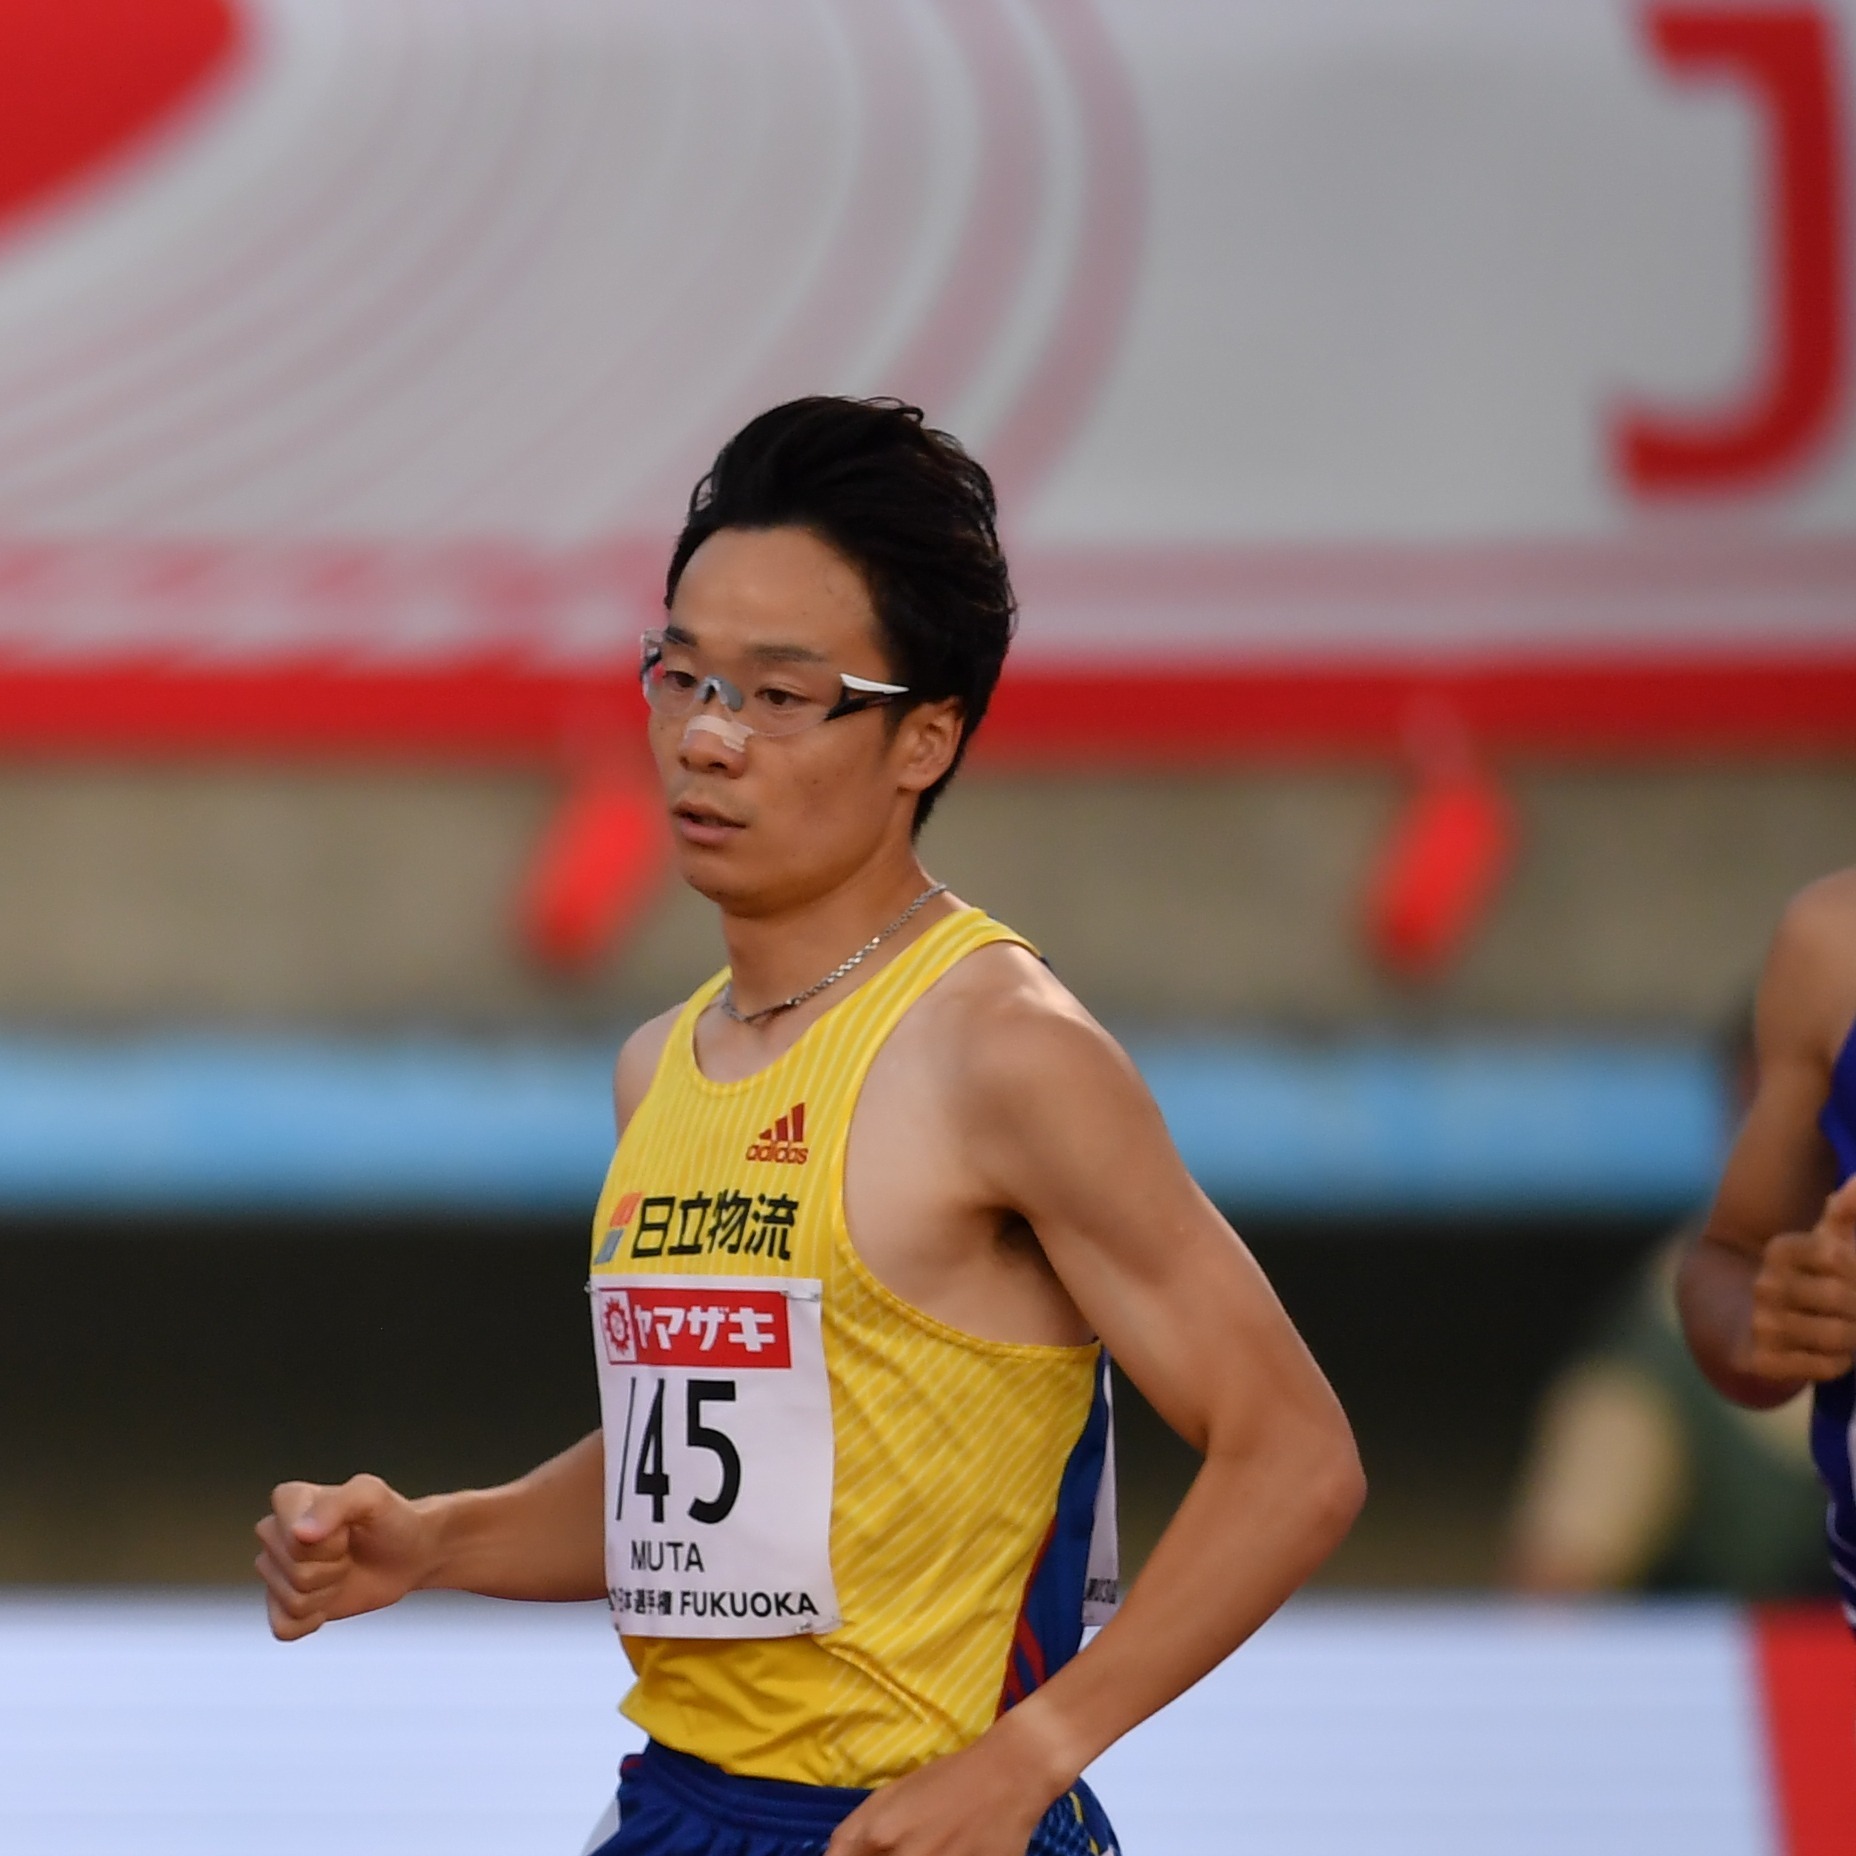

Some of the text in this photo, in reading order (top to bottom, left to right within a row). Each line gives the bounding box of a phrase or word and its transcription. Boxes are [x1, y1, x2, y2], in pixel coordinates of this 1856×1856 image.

[746, 1141, 809, 1165] adidas
[630, 1189, 800, 1261] 日立物流
[632, 1305, 776, 1353] ヤマザキ
[615, 1376, 742, 1525] 145
[631, 1540, 705, 1573] MUTA
[680, 1590, 819, 1618] FUKUOKA
